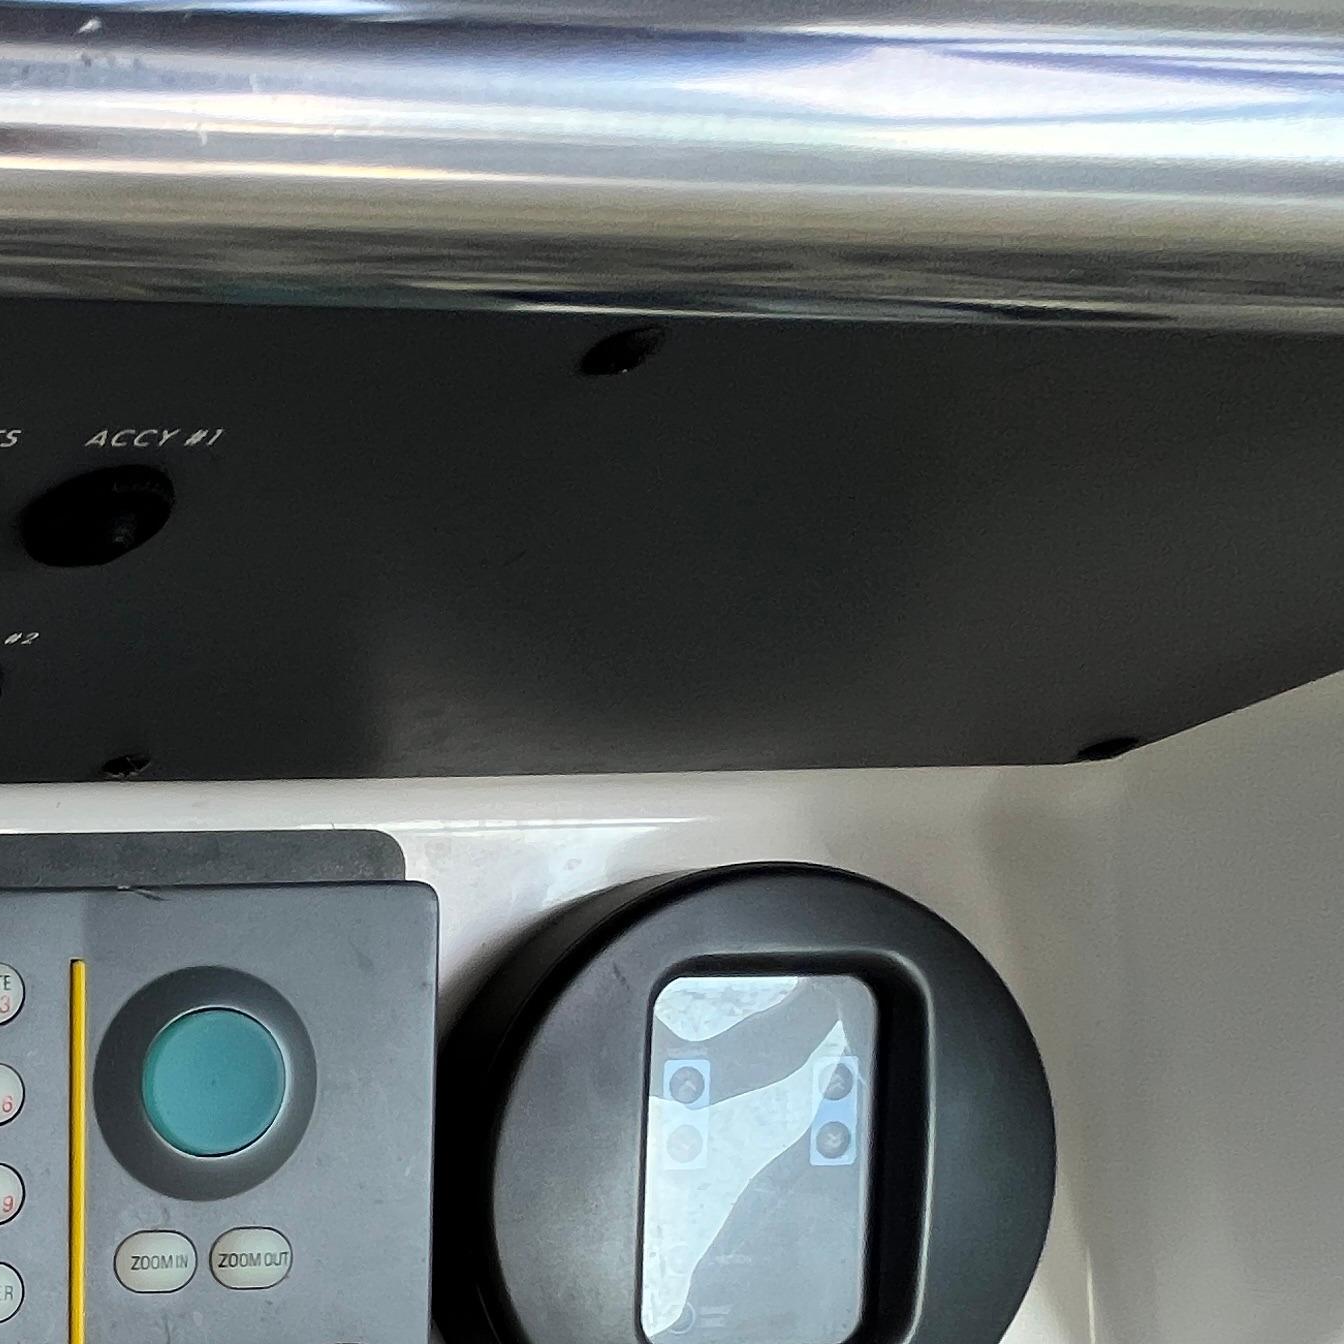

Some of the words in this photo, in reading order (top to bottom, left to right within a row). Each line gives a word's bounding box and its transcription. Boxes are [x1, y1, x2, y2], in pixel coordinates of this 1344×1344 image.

[85, 428, 181, 449] ACCY
[184, 427, 225, 448] #1
[3, 630, 41, 647] #2
[1, 1094, 14, 1114] 6
[2, 1195, 15, 1213] 9
[130, 1254, 174, 1271] ZOOM
[175, 1253, 190, 1268] IN
[217, 1251, 263, 1269] ZOOM
[264, 1250, 290, 1267] OUT
